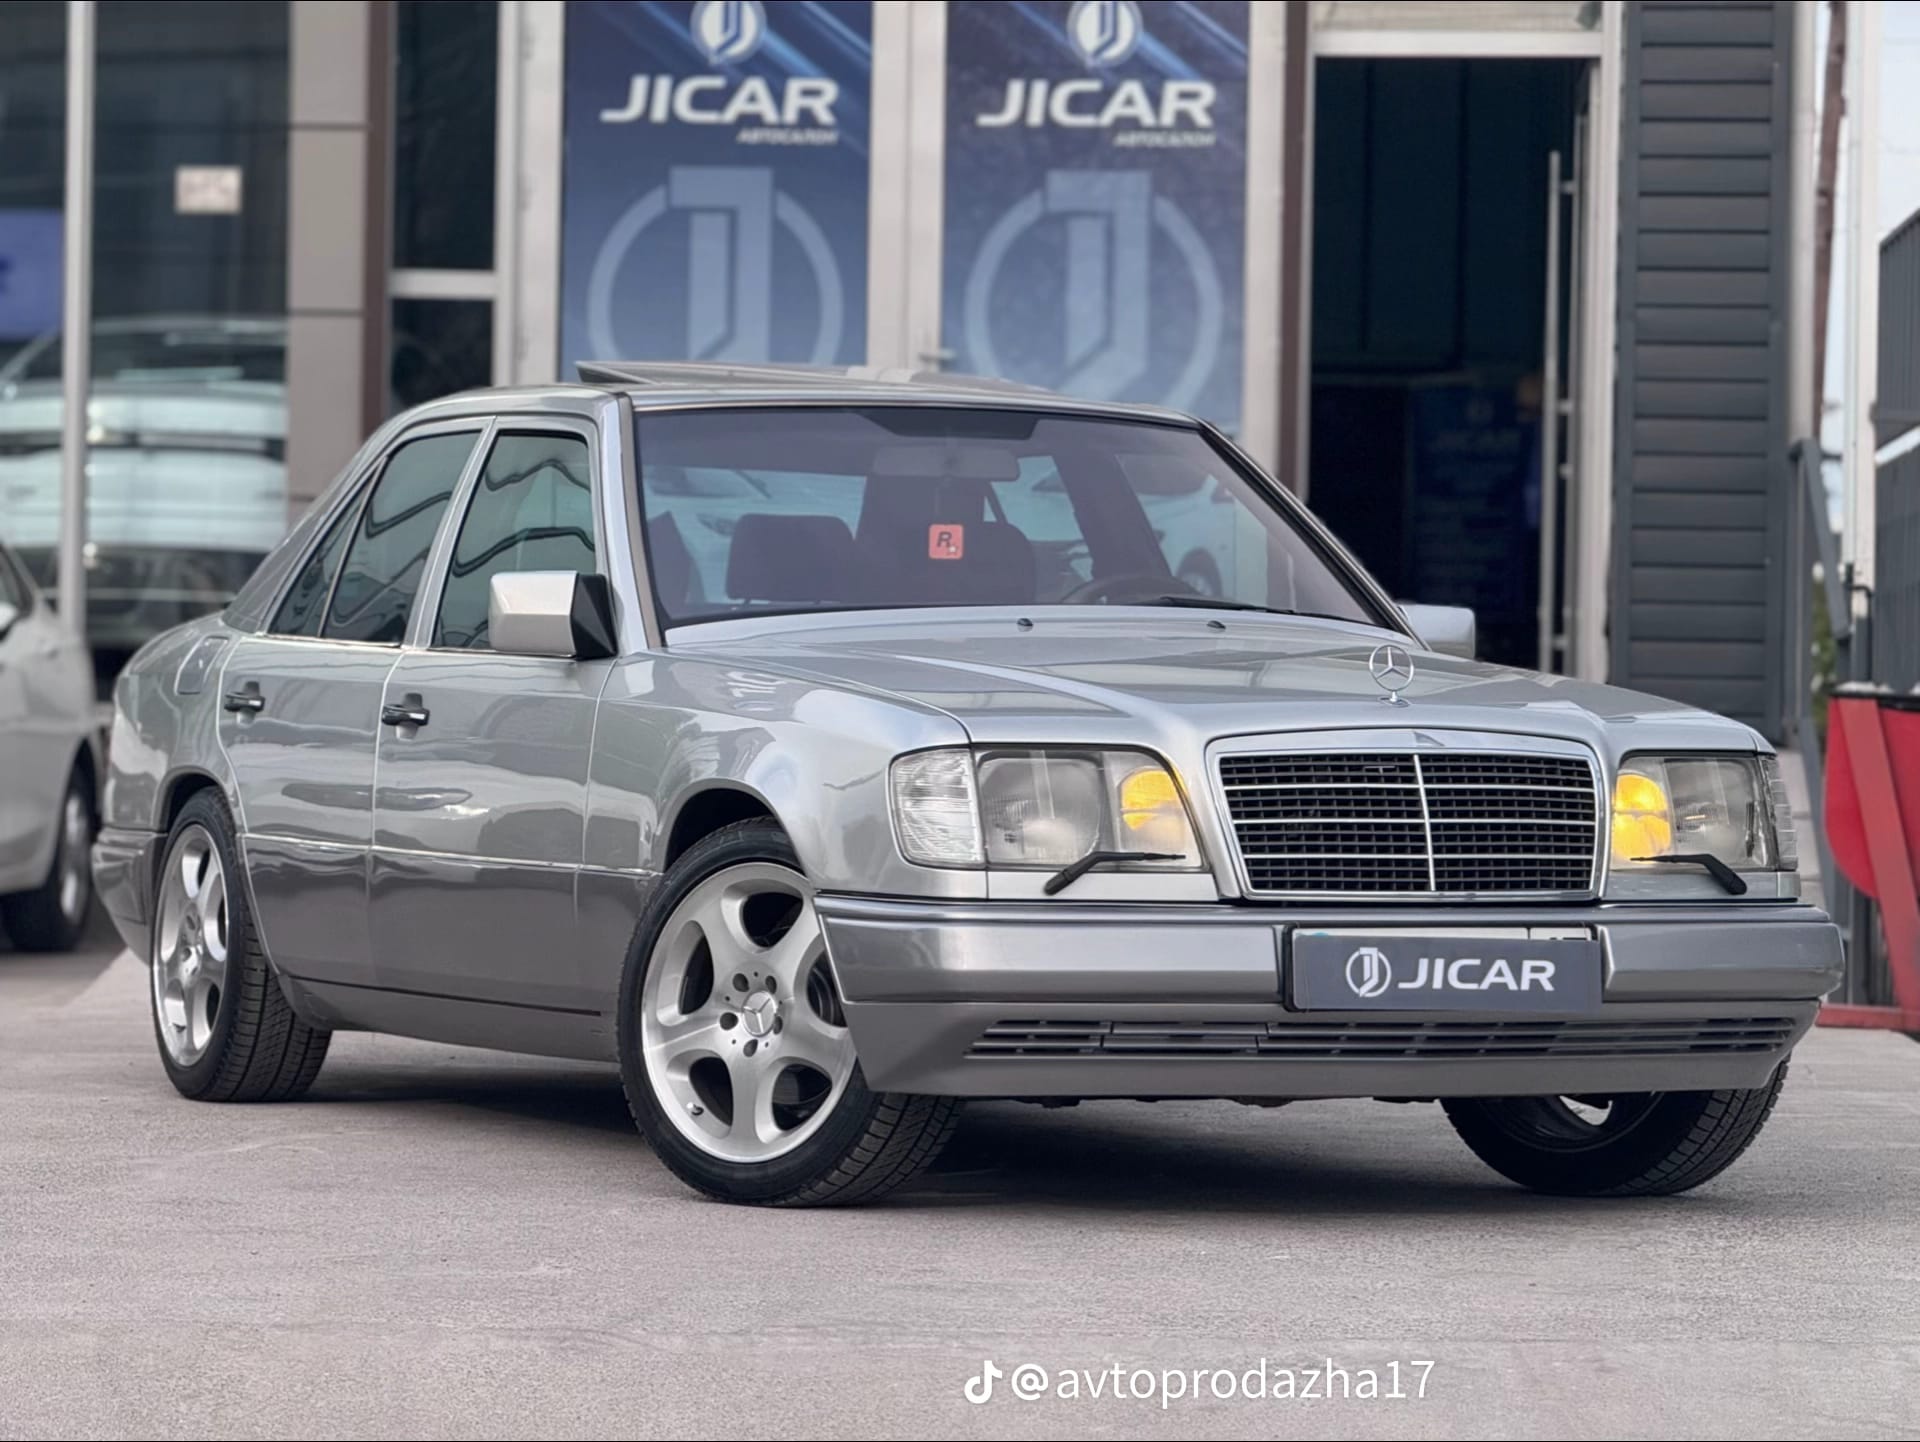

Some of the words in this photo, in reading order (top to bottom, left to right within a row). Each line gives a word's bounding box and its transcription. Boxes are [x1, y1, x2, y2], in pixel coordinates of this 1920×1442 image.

[600, 74, 839, 125] JICAR
[976, 78, 1217, 128] JICAR
[1398, 957, 1556, 992] JICAR
